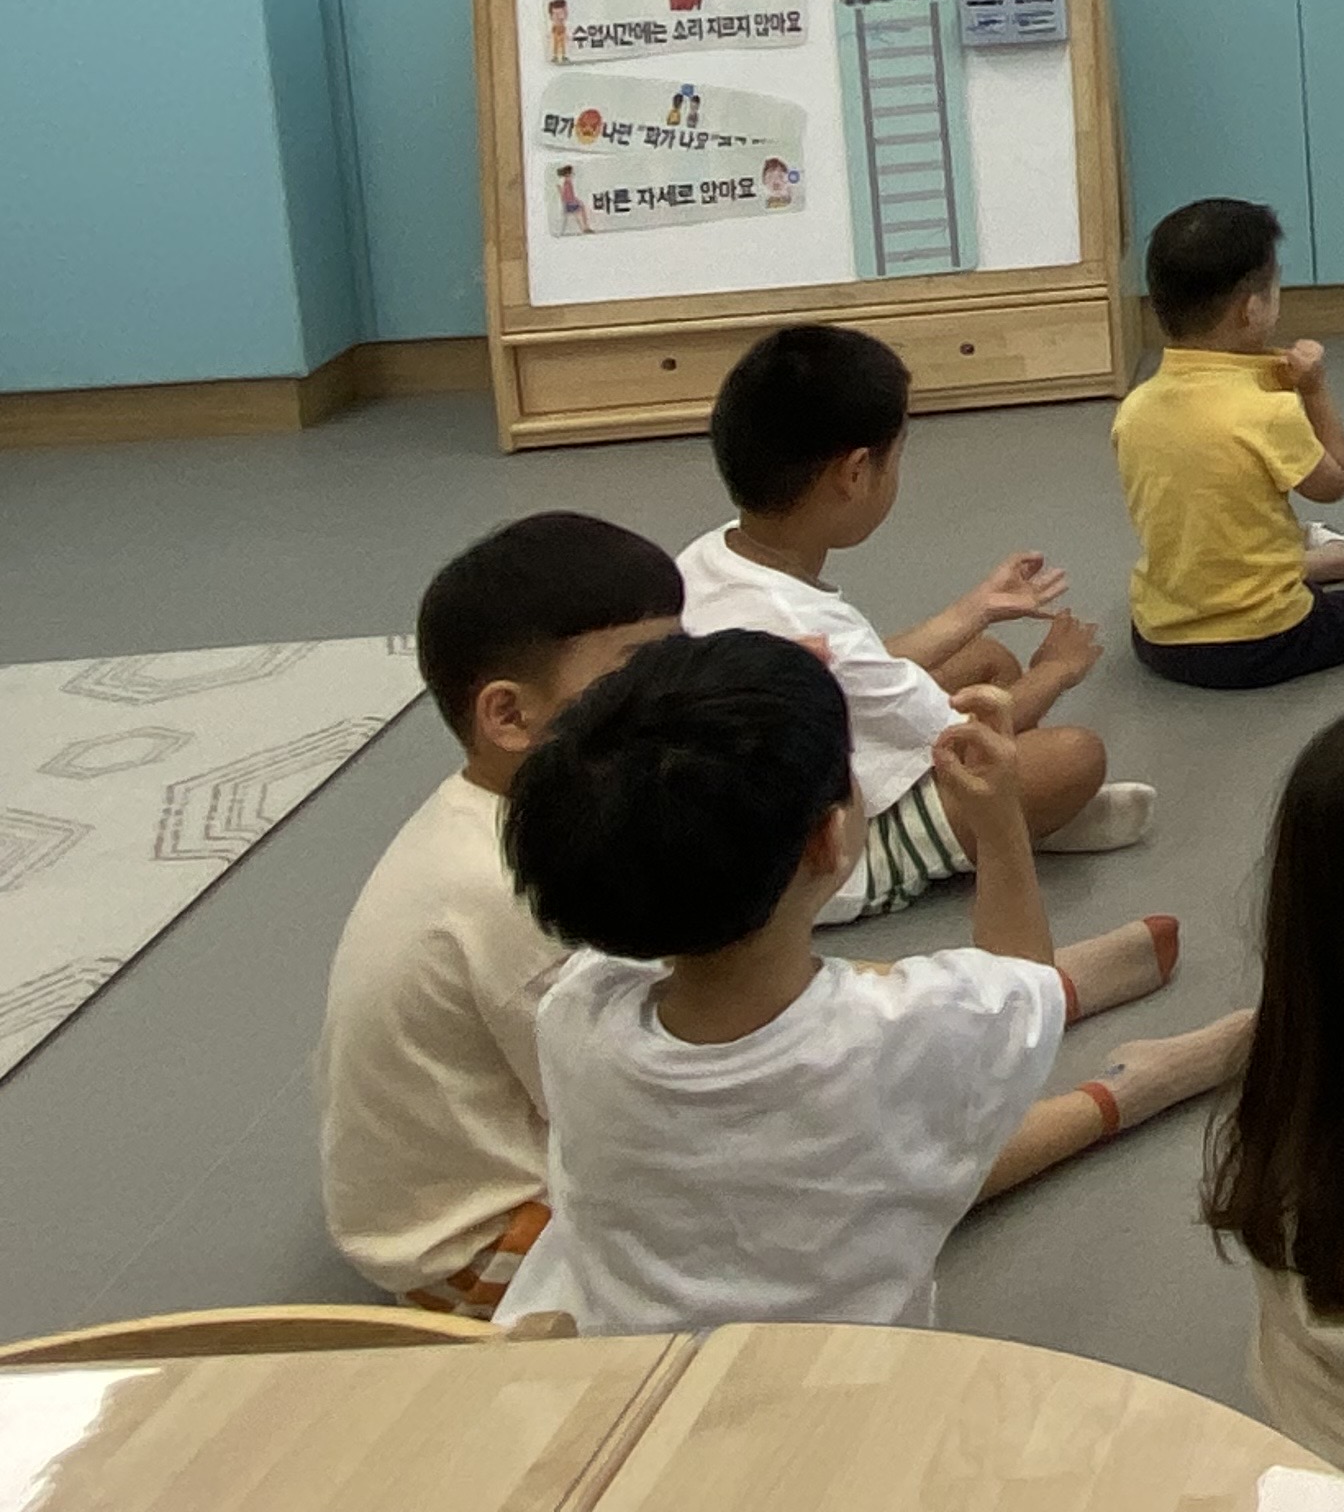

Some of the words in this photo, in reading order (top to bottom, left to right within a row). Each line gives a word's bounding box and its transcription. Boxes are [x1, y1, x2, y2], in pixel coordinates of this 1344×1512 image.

[572, 20, 667, 49] 수업시간에는
[672, 17, 704, 41] 소리
[707, 13, 751, 38] 지르지
[592, 187, 632, 216] 바른
[637, 182, 696, 210] 자세로
[700, 176, 757, 206] 앉아요
